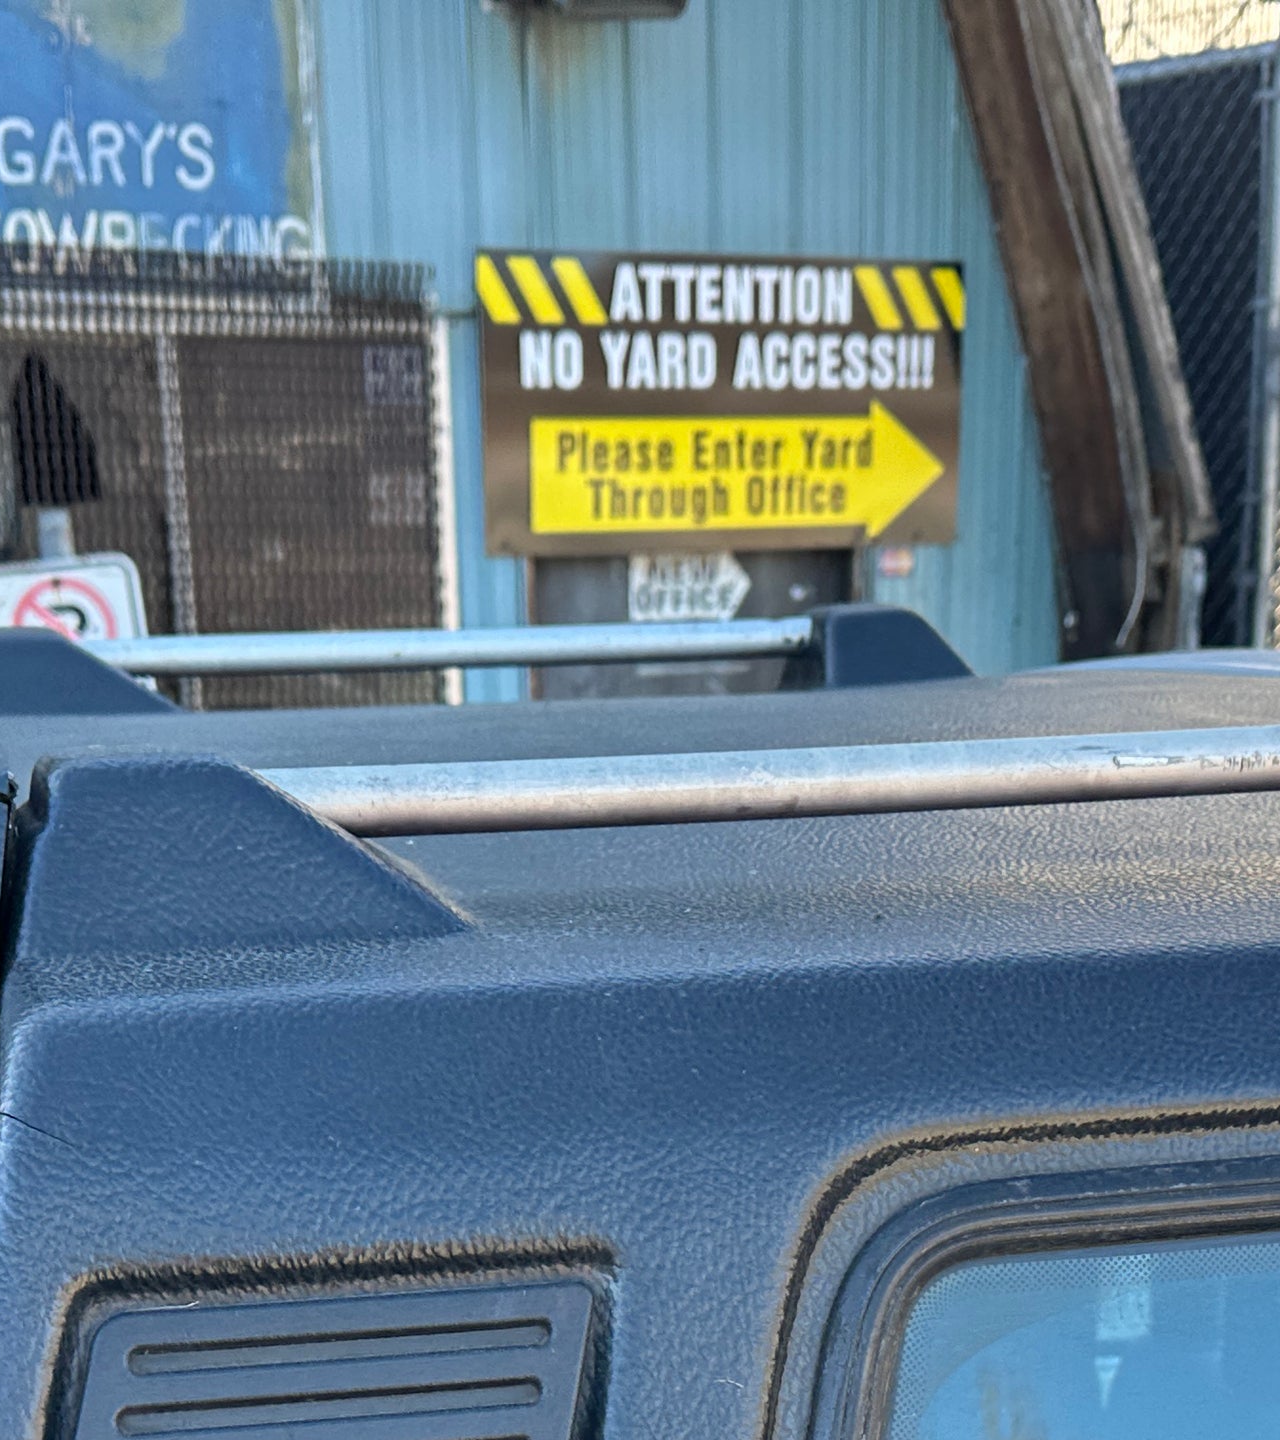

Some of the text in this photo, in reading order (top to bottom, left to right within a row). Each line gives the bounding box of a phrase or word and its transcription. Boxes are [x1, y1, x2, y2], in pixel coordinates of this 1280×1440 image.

[610, 262, 853, 325] ATTENTION
[520, 330, 935, 390] NO YARD ACCESS!!!
[557, 429, 875, 474] Please Enter Yard
[586, 476, 848, 524] Through Office
